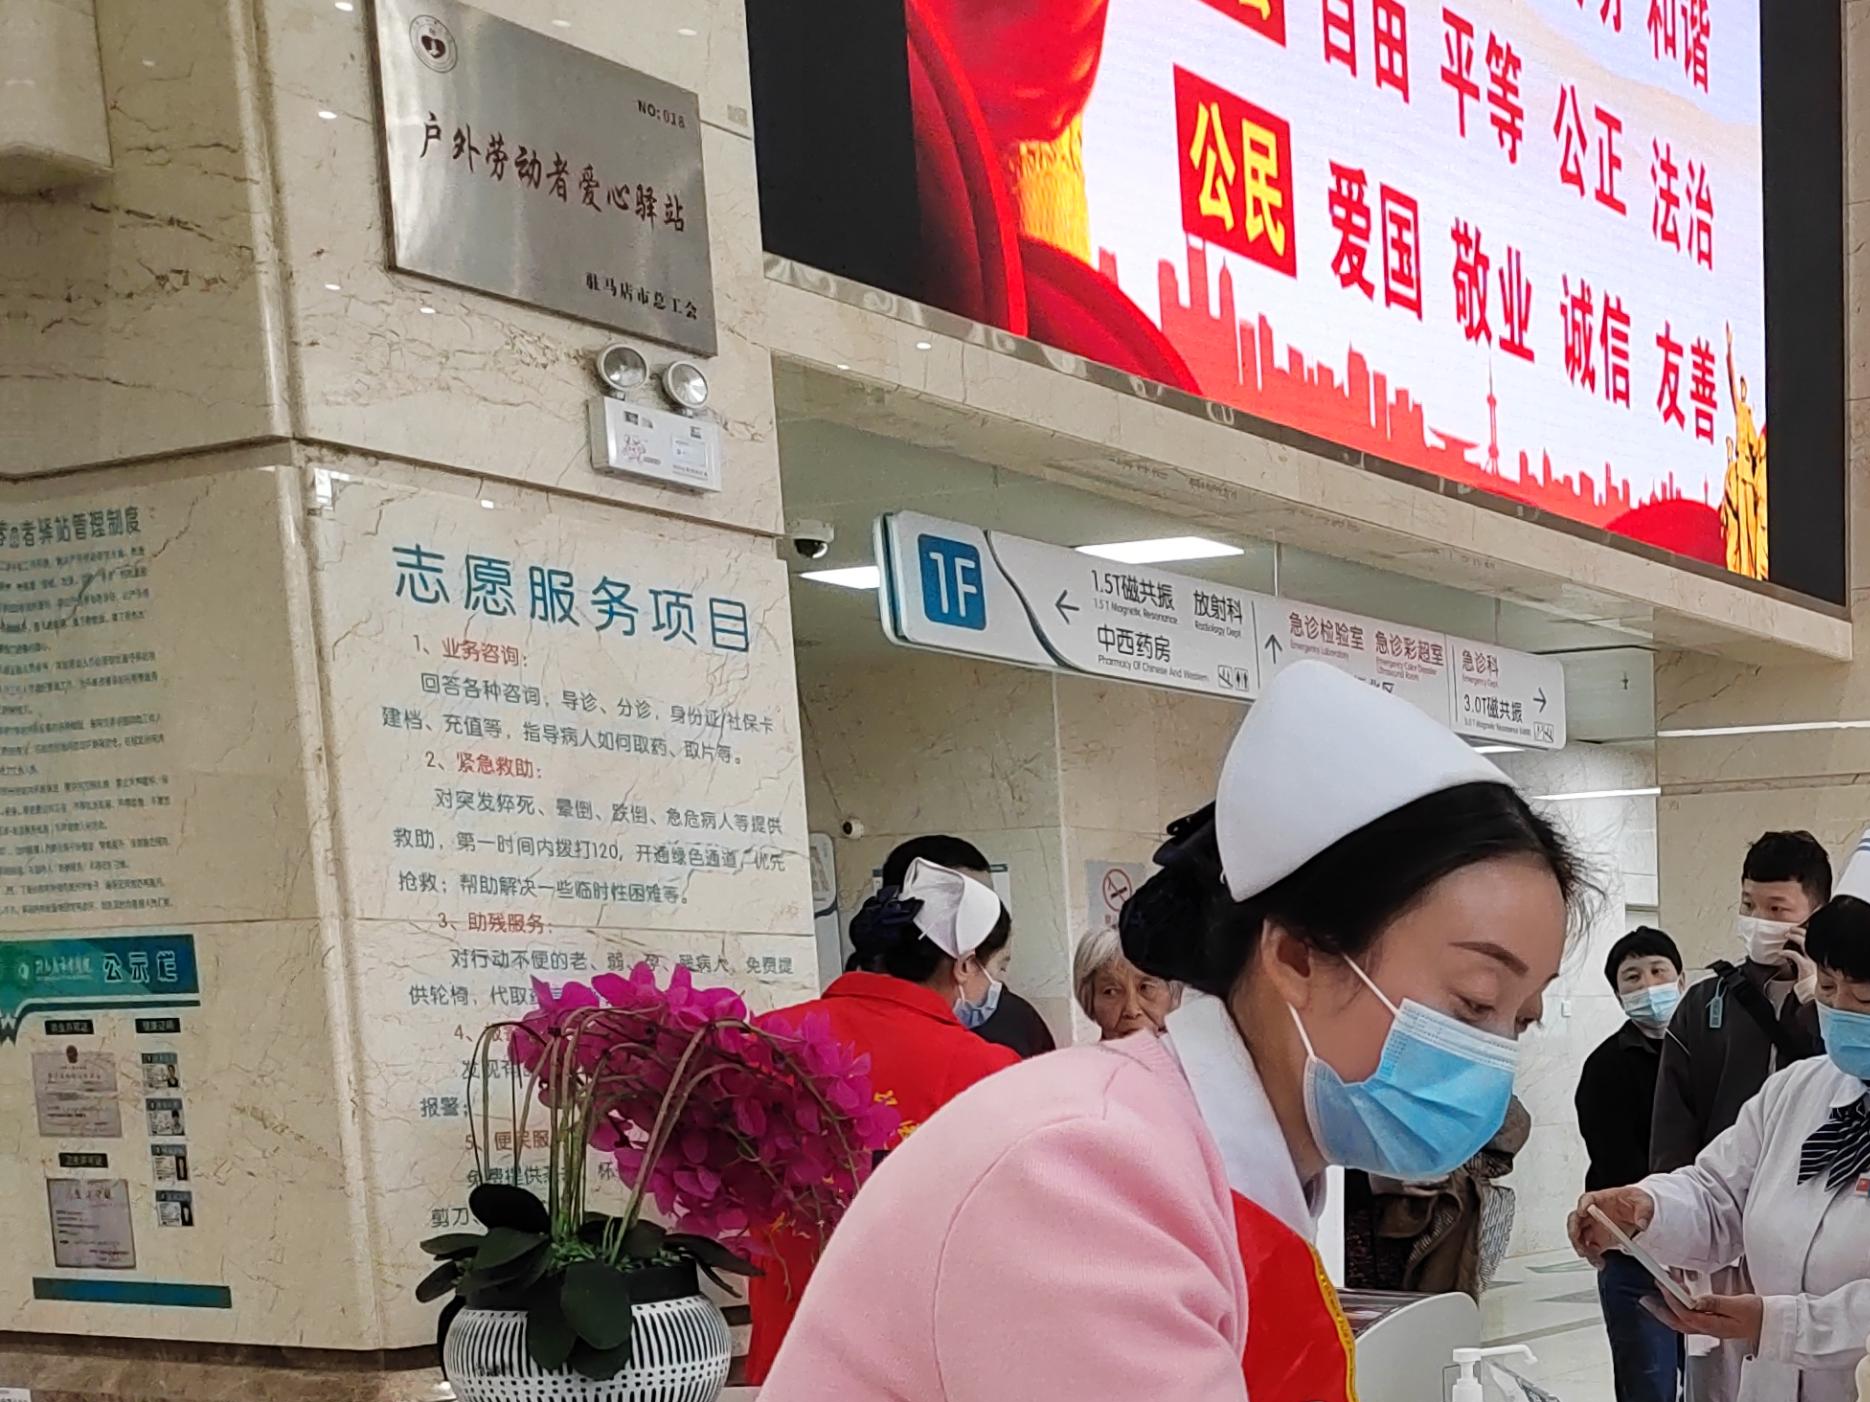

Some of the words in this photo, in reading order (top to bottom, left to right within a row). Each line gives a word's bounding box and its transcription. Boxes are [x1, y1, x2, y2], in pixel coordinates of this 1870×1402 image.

[1647, 0, 1710, 94] 和谐
[420, 111, 685, 232] 户外劳动者爱心驿站
[1440, 8, 1524, 164] 平等
[1554, 84, 1627, 217] 公正
[1651, 137, 1715, 271] 法治
[1189, 101, 1286, 258] 公民
[585, 272, 698, 320] 驻马店市总工会
[1328, 160, 1423, 320] 爱国
[1451, 217, 1535, 363] 敬业
[1561, 274, 1632, 409] 诚信
[1655, 322, 1719, 445] 友善
[392, 543, 750, 653] 志愿服务项目
[928, 551, 977, 618] 1F
[1091, 569, 1176, 611] 1.5T磁共振
[1193, 590, 1243, 624] 放射科
[1097, 623, 1171, 662] 中西药房
[1289, 611, 1364, 651] 急诊检验室
[1375, 630, 1444, 666] 急诊彩超室
[1462, 650, 1499, 678] 急诊科
[1463, 693, 1523, 723] 3.0T磁共振
